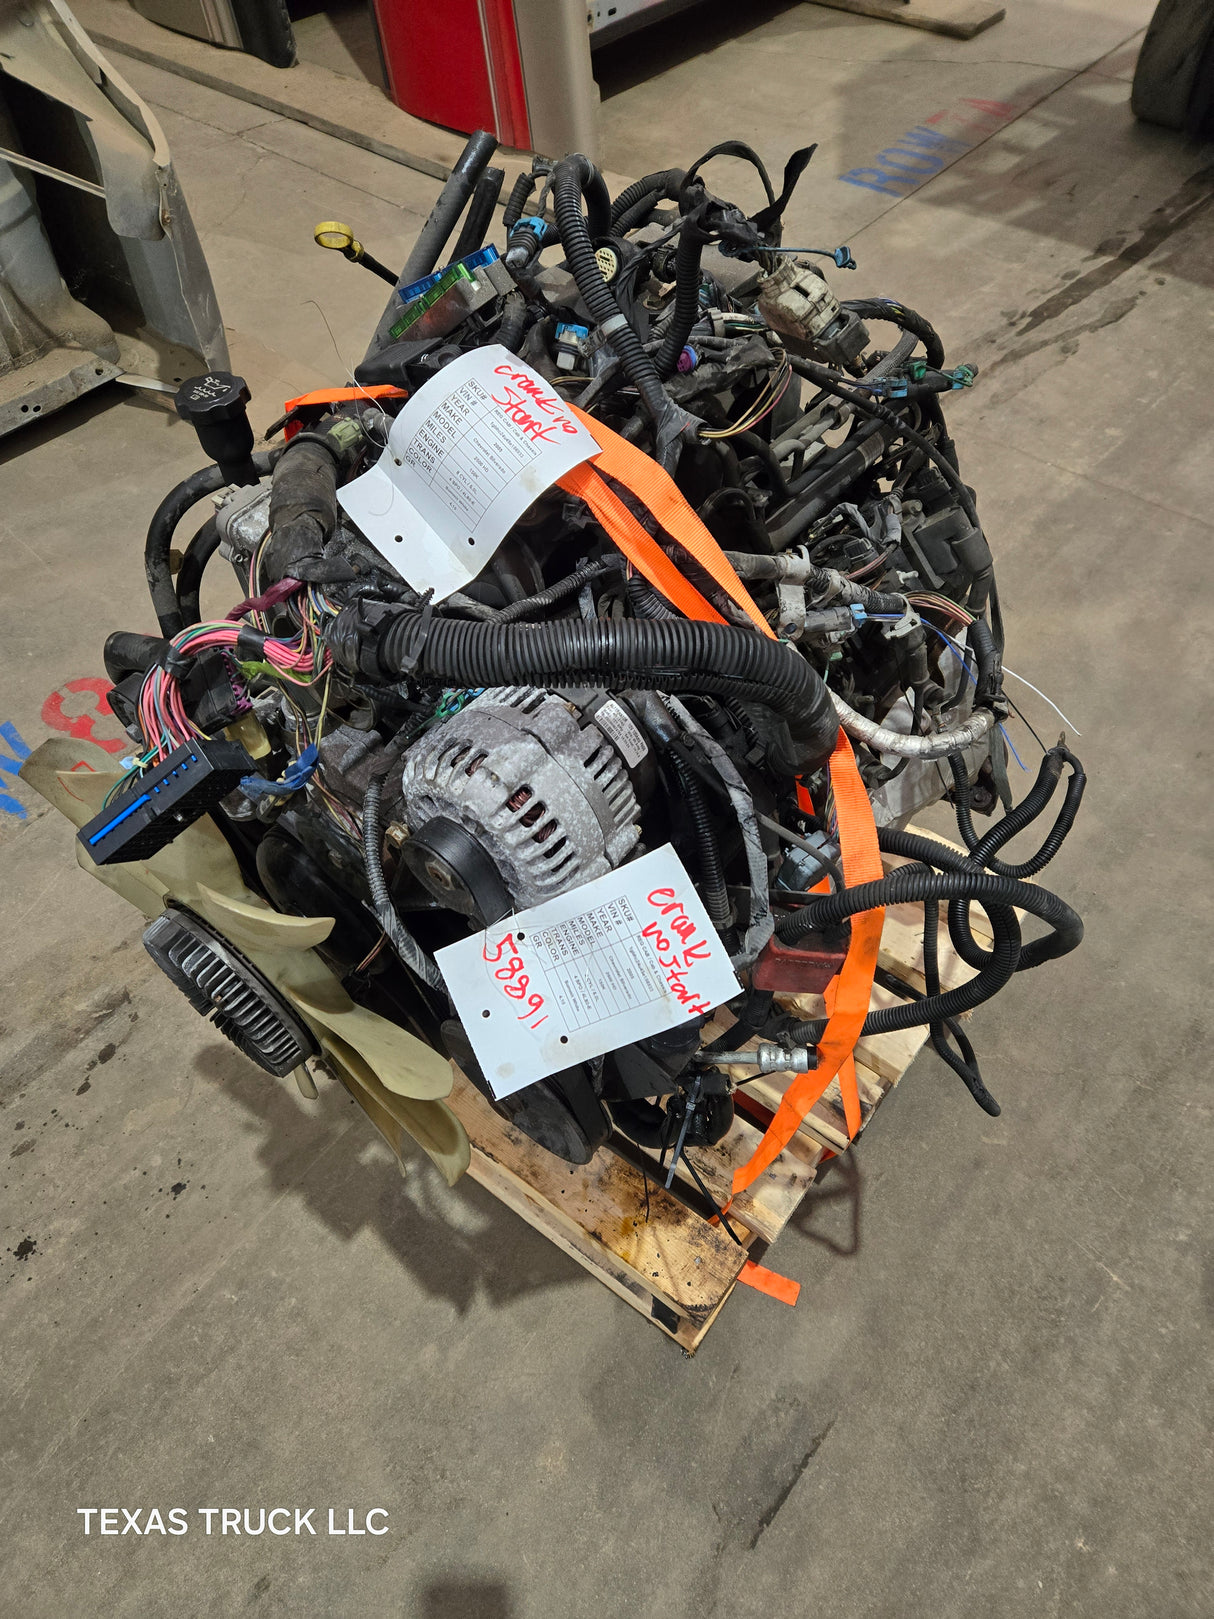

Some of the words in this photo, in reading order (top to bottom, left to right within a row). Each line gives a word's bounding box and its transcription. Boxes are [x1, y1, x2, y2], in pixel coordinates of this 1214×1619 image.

[838, 125, 972, 198] ROW
[459, 387, 472, 401] VIN
[470, 399, 478, 407] #
[467, 380, 488, 401] SKU#
[450, 395, 470, 416] YEAR
[425, 420, 447, 444] MILES
[432, 411, 458, 438] MODEL
[412, 438, 436, 464] TRANS
[418, 429, 445, 458] ENGINE
[441, 402, 463, 426] MAKE
[472, 437, 490, 456] Chevrolet
[488, 455, 506, 474] Silverado
[405, 455, 417, 467] GR
[407, 447, 433, 474] COLOR
[597, 908, 613, 933] YEAR
[607, 903, 619, 919] VIN
[617, 898, 634, 922] SKU#
[532, 934, 543, 949] GR
[551, 928, 569, 957] TRANS
[559, 924, 579, 956] ENGINE
[568, 920, 586, 946] MILES
[577, 916, 596, 947] MODEL
[542, 931, 560, 962] COLOR
[586, 912, 603, 938] MAKE
[608, 955, 622, 977] Chevrolet
[619, 978, 632, 999] Silverado
[483, 932, 549, 1030] 58891
